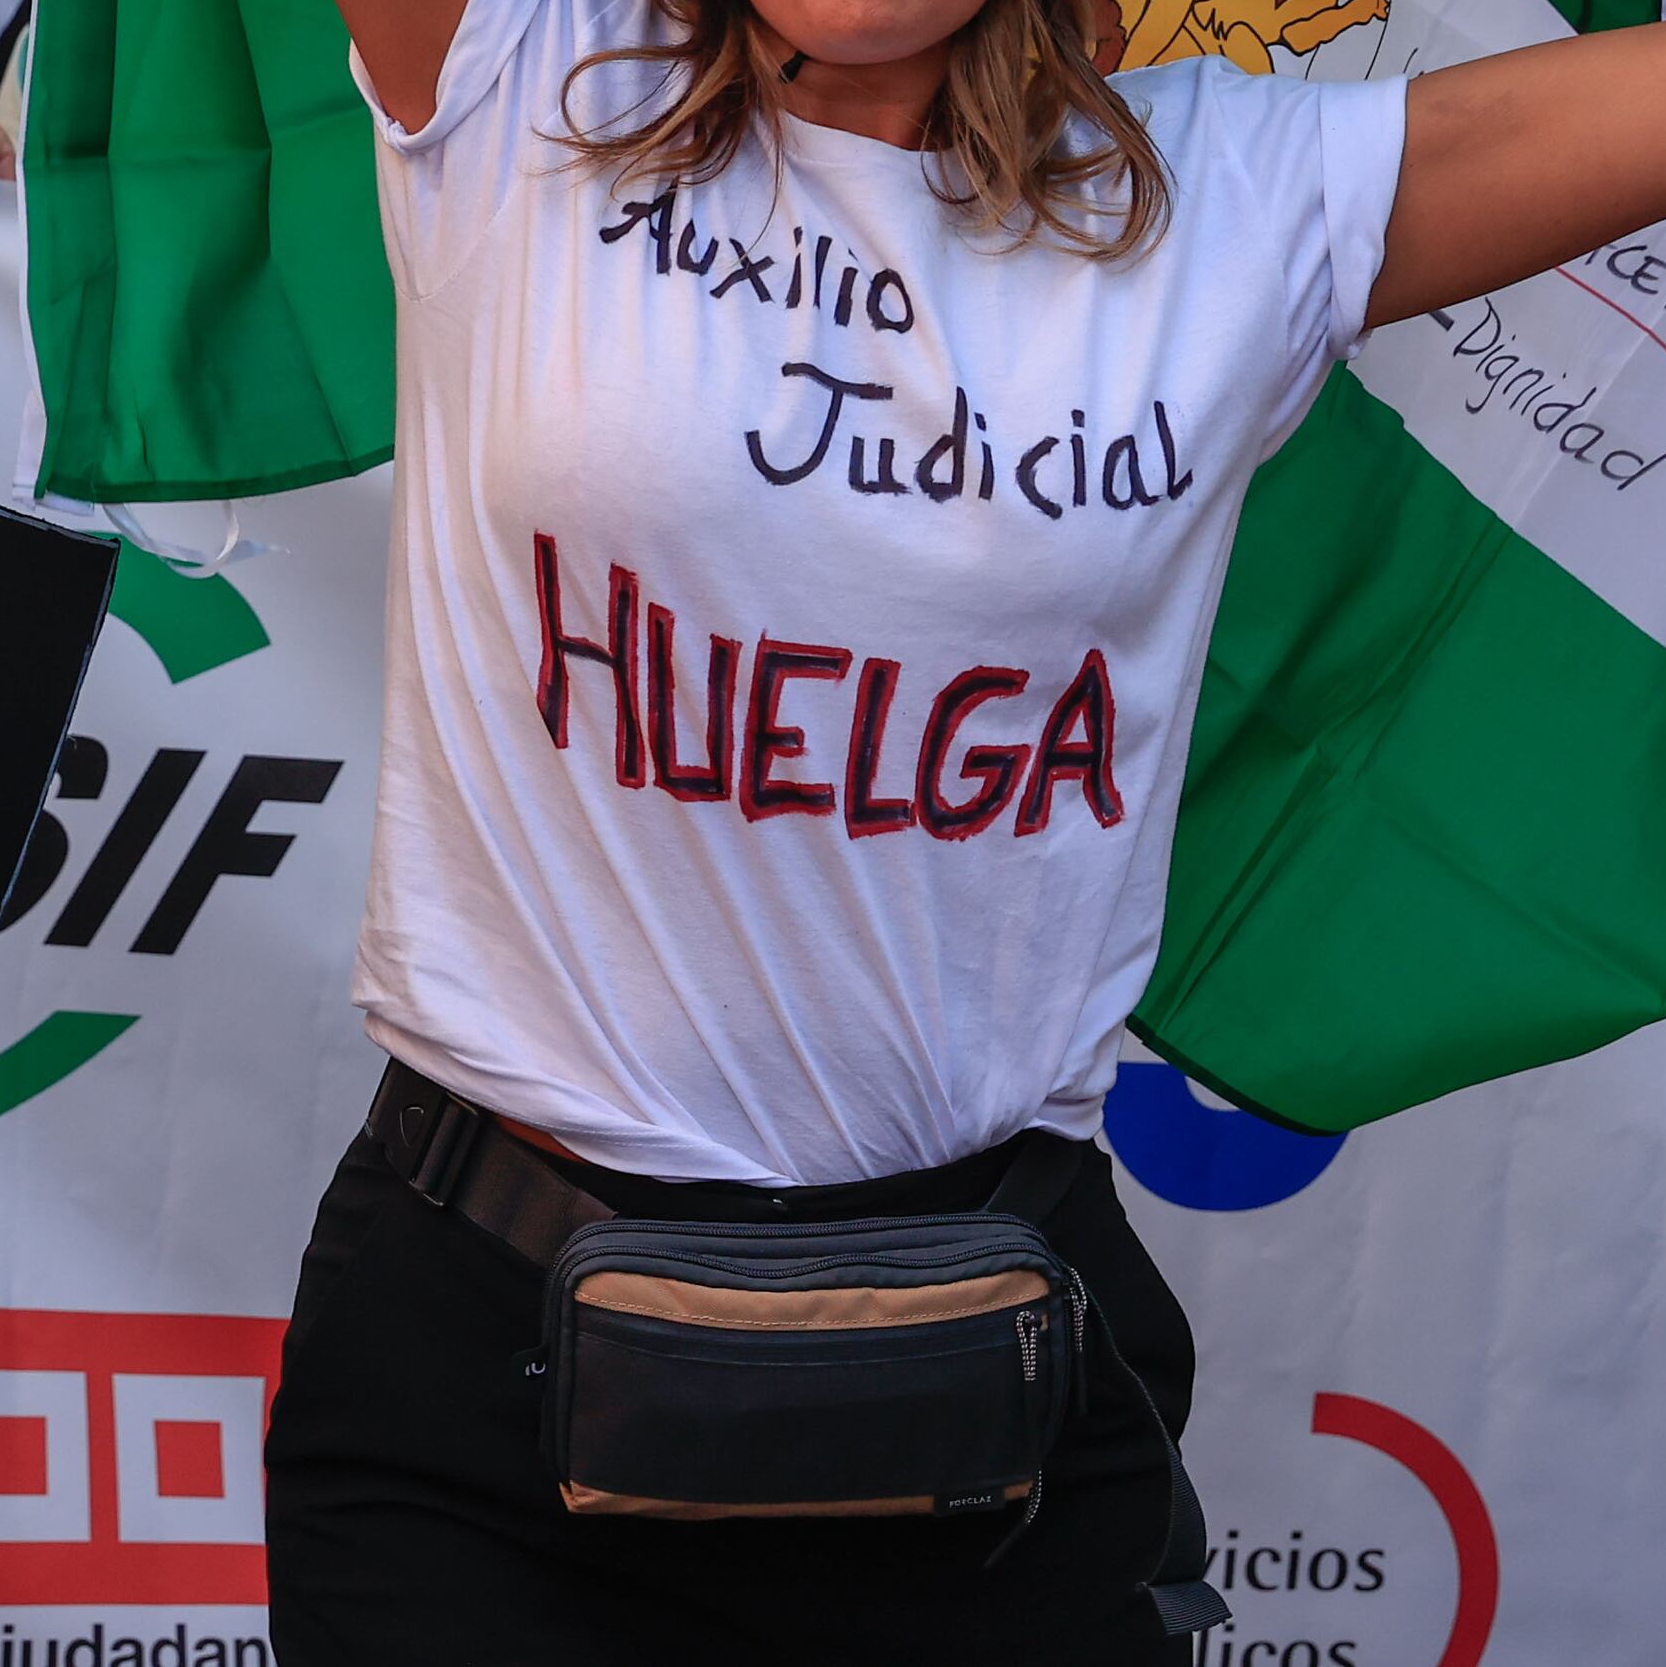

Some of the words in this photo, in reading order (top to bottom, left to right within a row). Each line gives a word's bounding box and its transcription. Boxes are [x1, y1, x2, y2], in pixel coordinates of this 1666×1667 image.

[598, 181, 916, 336] Auxilio
[744, 361, 1195, 520] Judicial
[533, 529, 1127, 843] HUELGA
